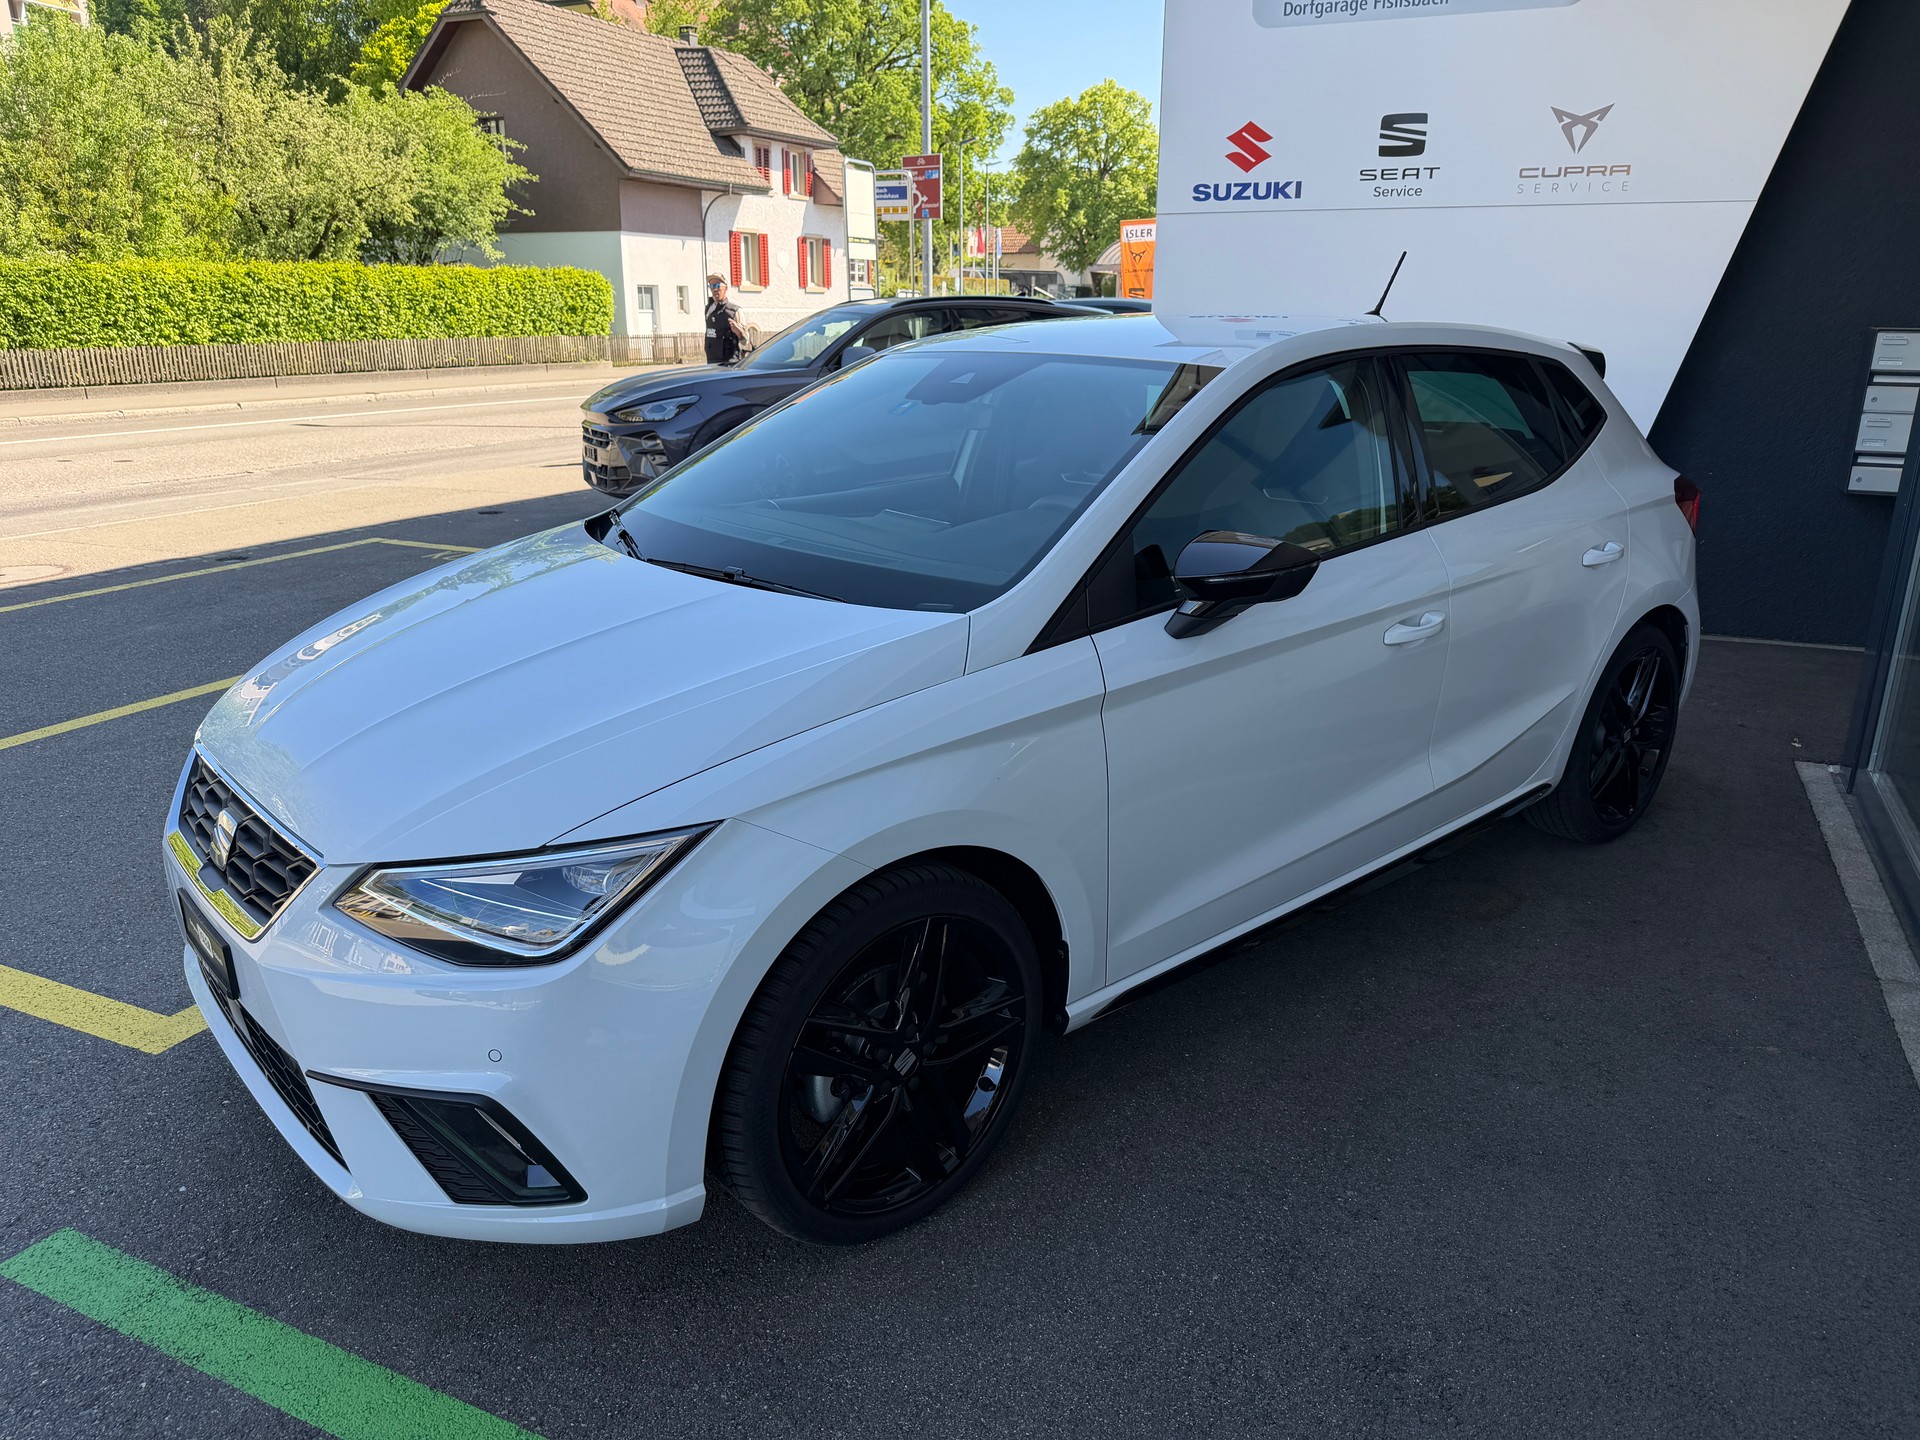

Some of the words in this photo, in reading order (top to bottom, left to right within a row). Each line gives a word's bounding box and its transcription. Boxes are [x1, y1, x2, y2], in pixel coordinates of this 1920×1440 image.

[1283, 0, 1368, 18] Dorfgarage
[1359, 167, 1441, 181] SEAT
[1519, 165, 1631, 178] CUPRA
[1192, 181, 1302, 202] SUZUKI
[1373, 185, 1423, 197] Service
[1517, 181, 1629, 194] SERVICE
